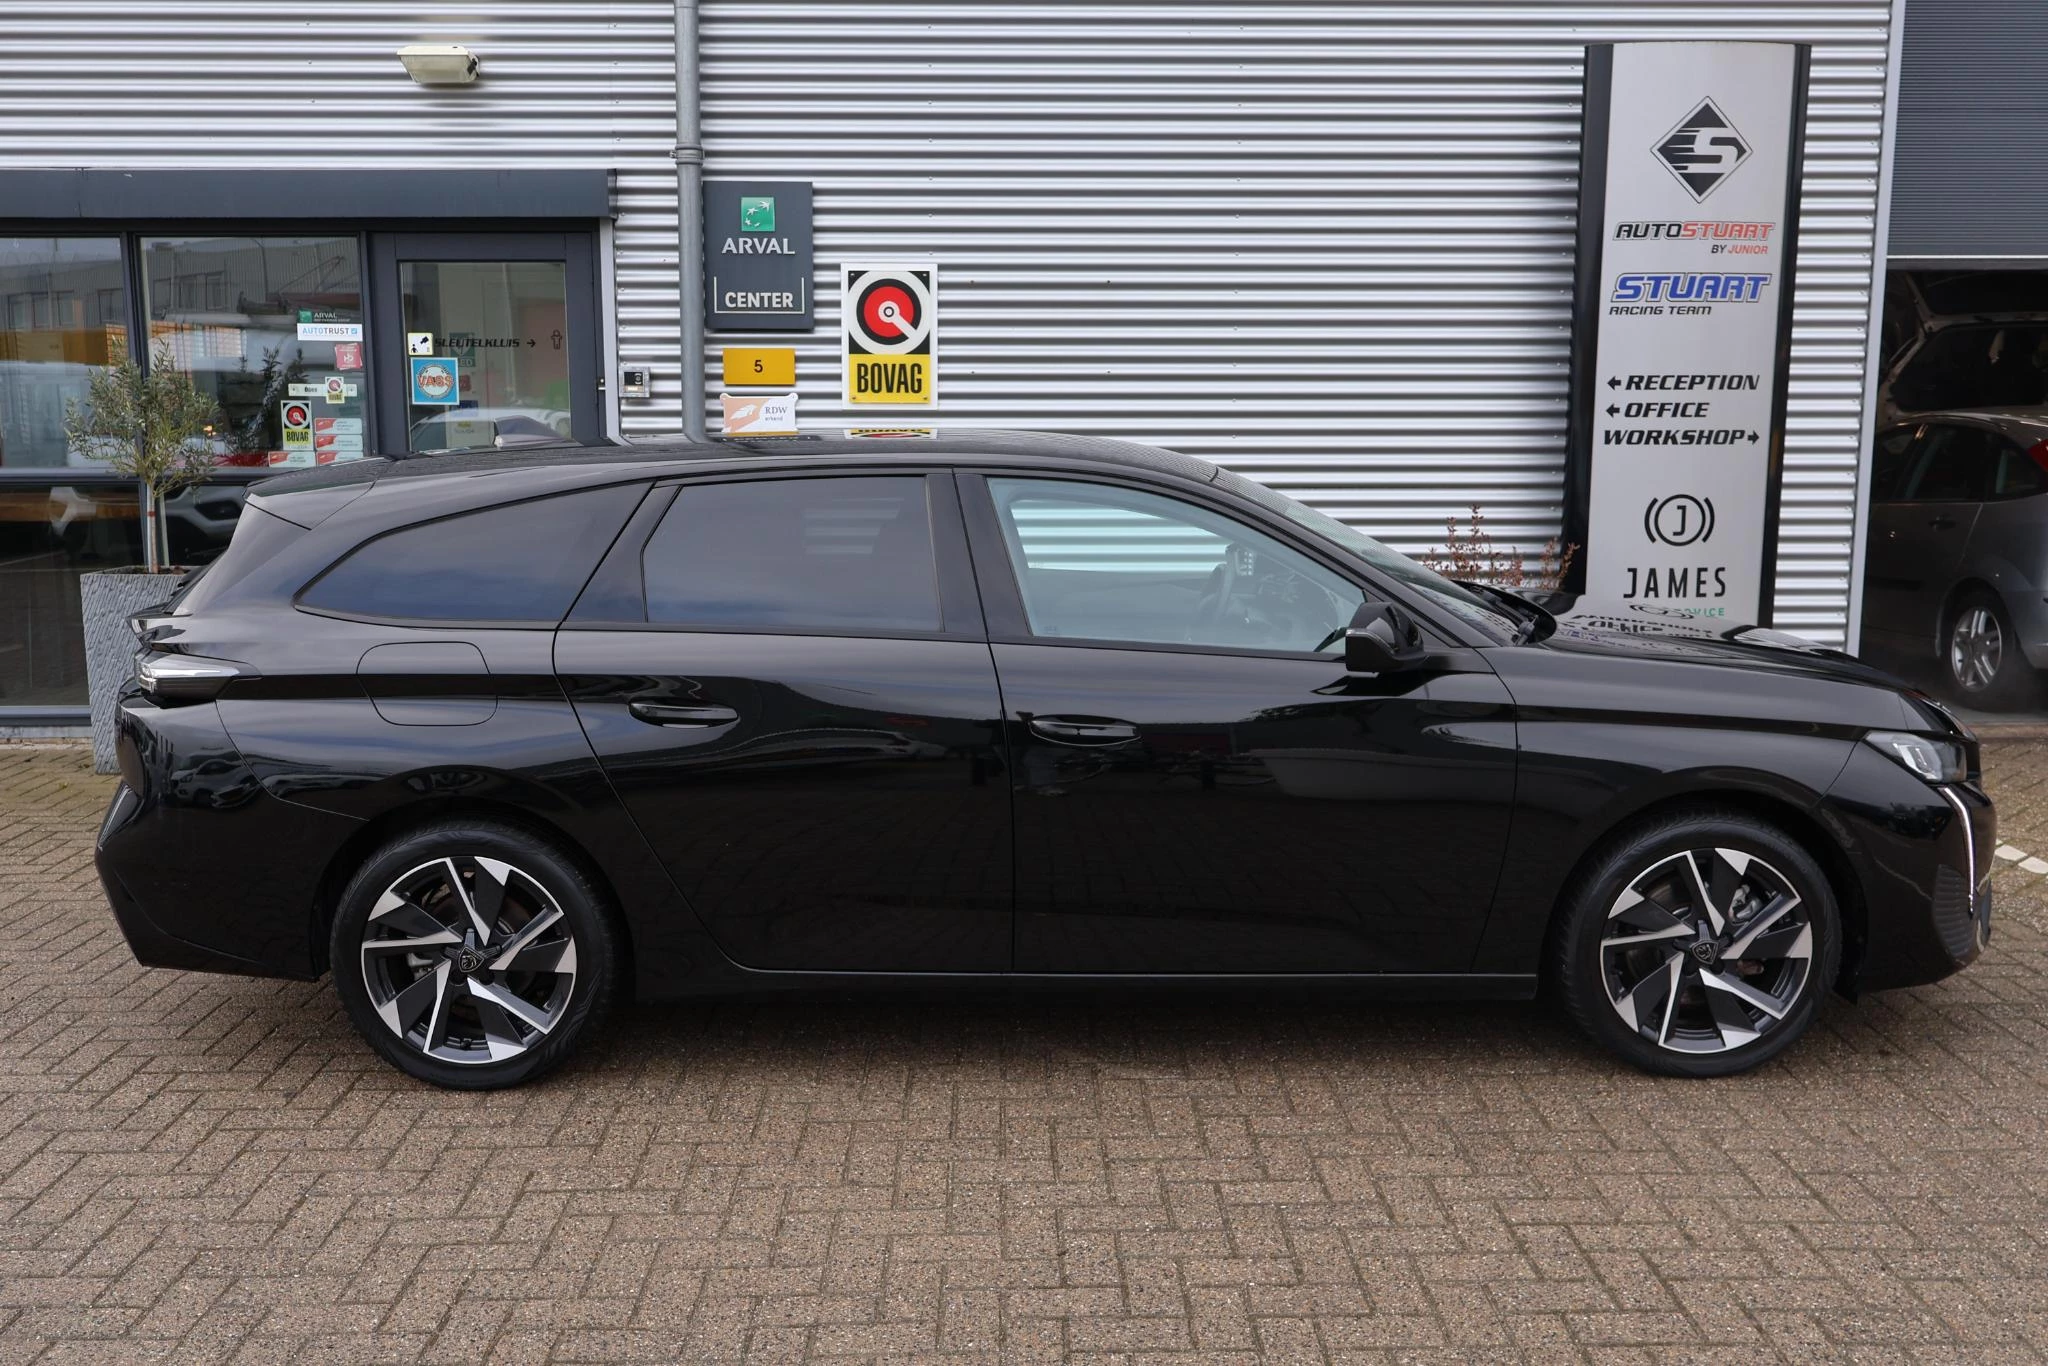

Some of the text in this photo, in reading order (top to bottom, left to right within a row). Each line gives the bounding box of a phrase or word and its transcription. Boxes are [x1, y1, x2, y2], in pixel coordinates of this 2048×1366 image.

[1614, 222, 1774, 241] AUTOSTUART
[721, 237, 796, 255] ARVAL
[1711, 245, 1769, 255] BY JUNIOR
[1611, 273, 1772, 303] STUART
[725, 292, 794, 308] CENTER
[1609, 305, 1712, 316] RACING TEAM
[302, 327, 350, 335] AUTOTRUST
[433, 338, 520, 348] SLEUTELKLUIS
[459, 357, 474, 367] ED
[753, 359, 763, 374] 5
[856, 362, 923, 394] BOVAG
[1625, 375, 1760, 390] RECEPTION
[765, 406, 787, 414] RDW
[1624, 402, 1710, 418] OFFICE
[286, 430, 308, 442] BOVAG
[1603, 430, 1745, 445] WORKSHOP
[1672, 505, 1687, 537] J
[1623, 567, 1726, 599] JAMES
